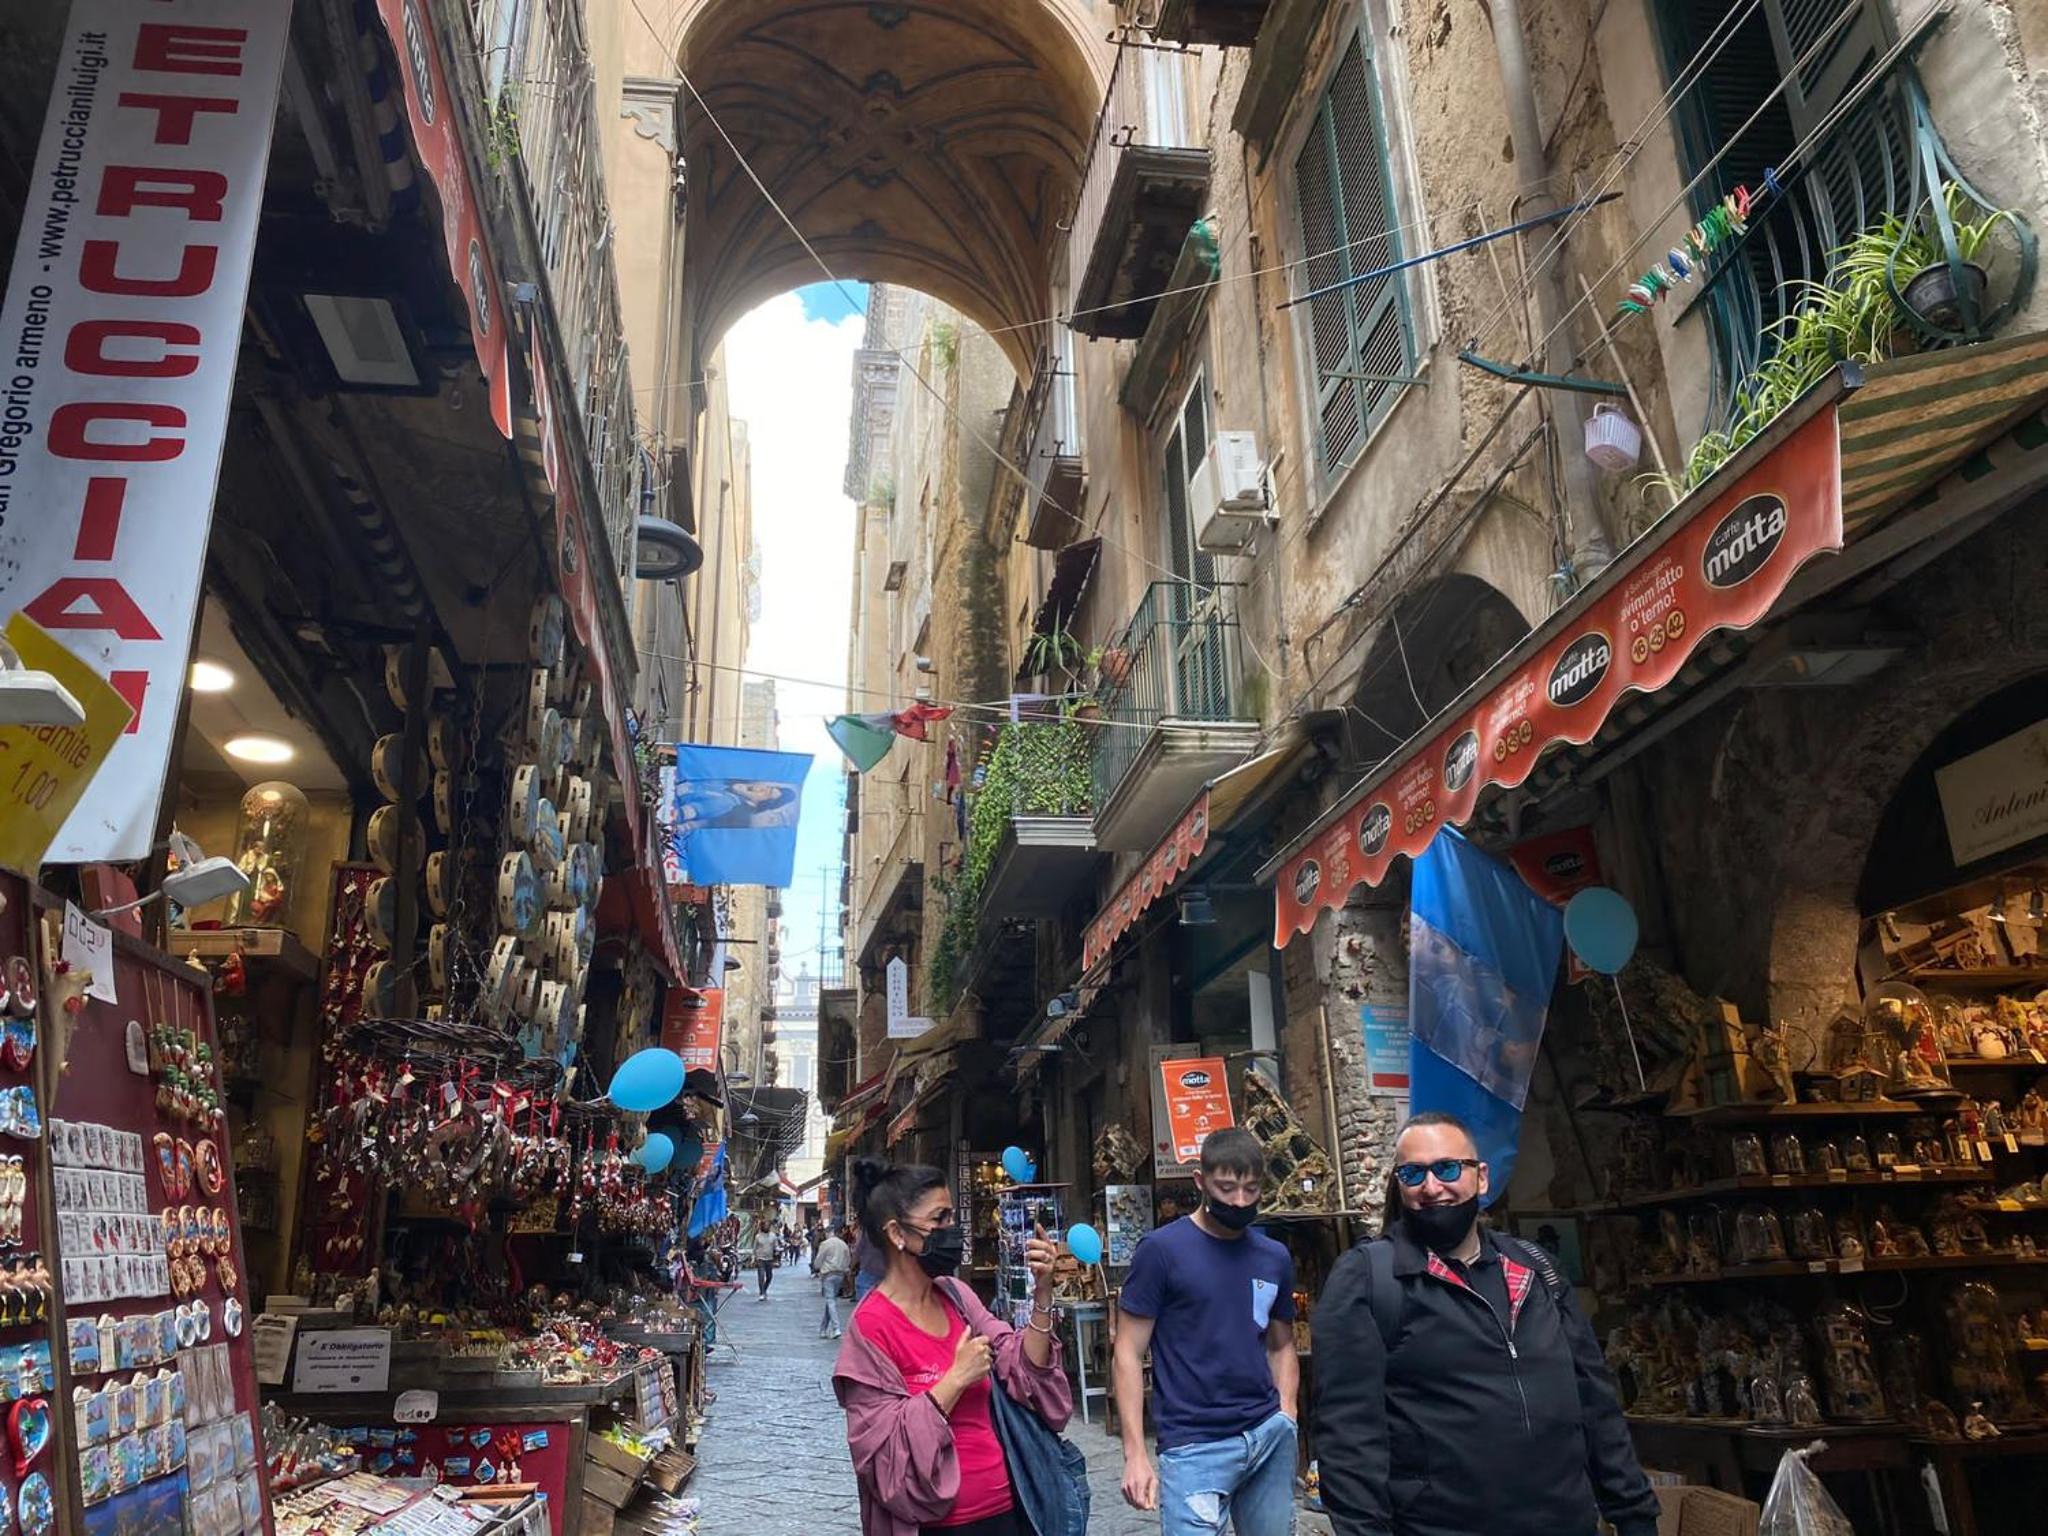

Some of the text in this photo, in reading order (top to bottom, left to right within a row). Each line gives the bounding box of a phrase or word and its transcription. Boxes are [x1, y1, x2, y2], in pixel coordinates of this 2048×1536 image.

[16, 285, 53, 369] armeno
[37, 31, 109, 260] www.petruccianiluigi.it
[1706, 506, 1785, 582] motta
[1654, 565, 1684, 596] fatto
[1550, 644, 1610, 700] motta
[1445, 742, 1478, 784] motta
[1360, 813, 1392, 847] motta
[1296, 869, 1321, 898] motta
[1182, 1074, 1211, 1086] motta
